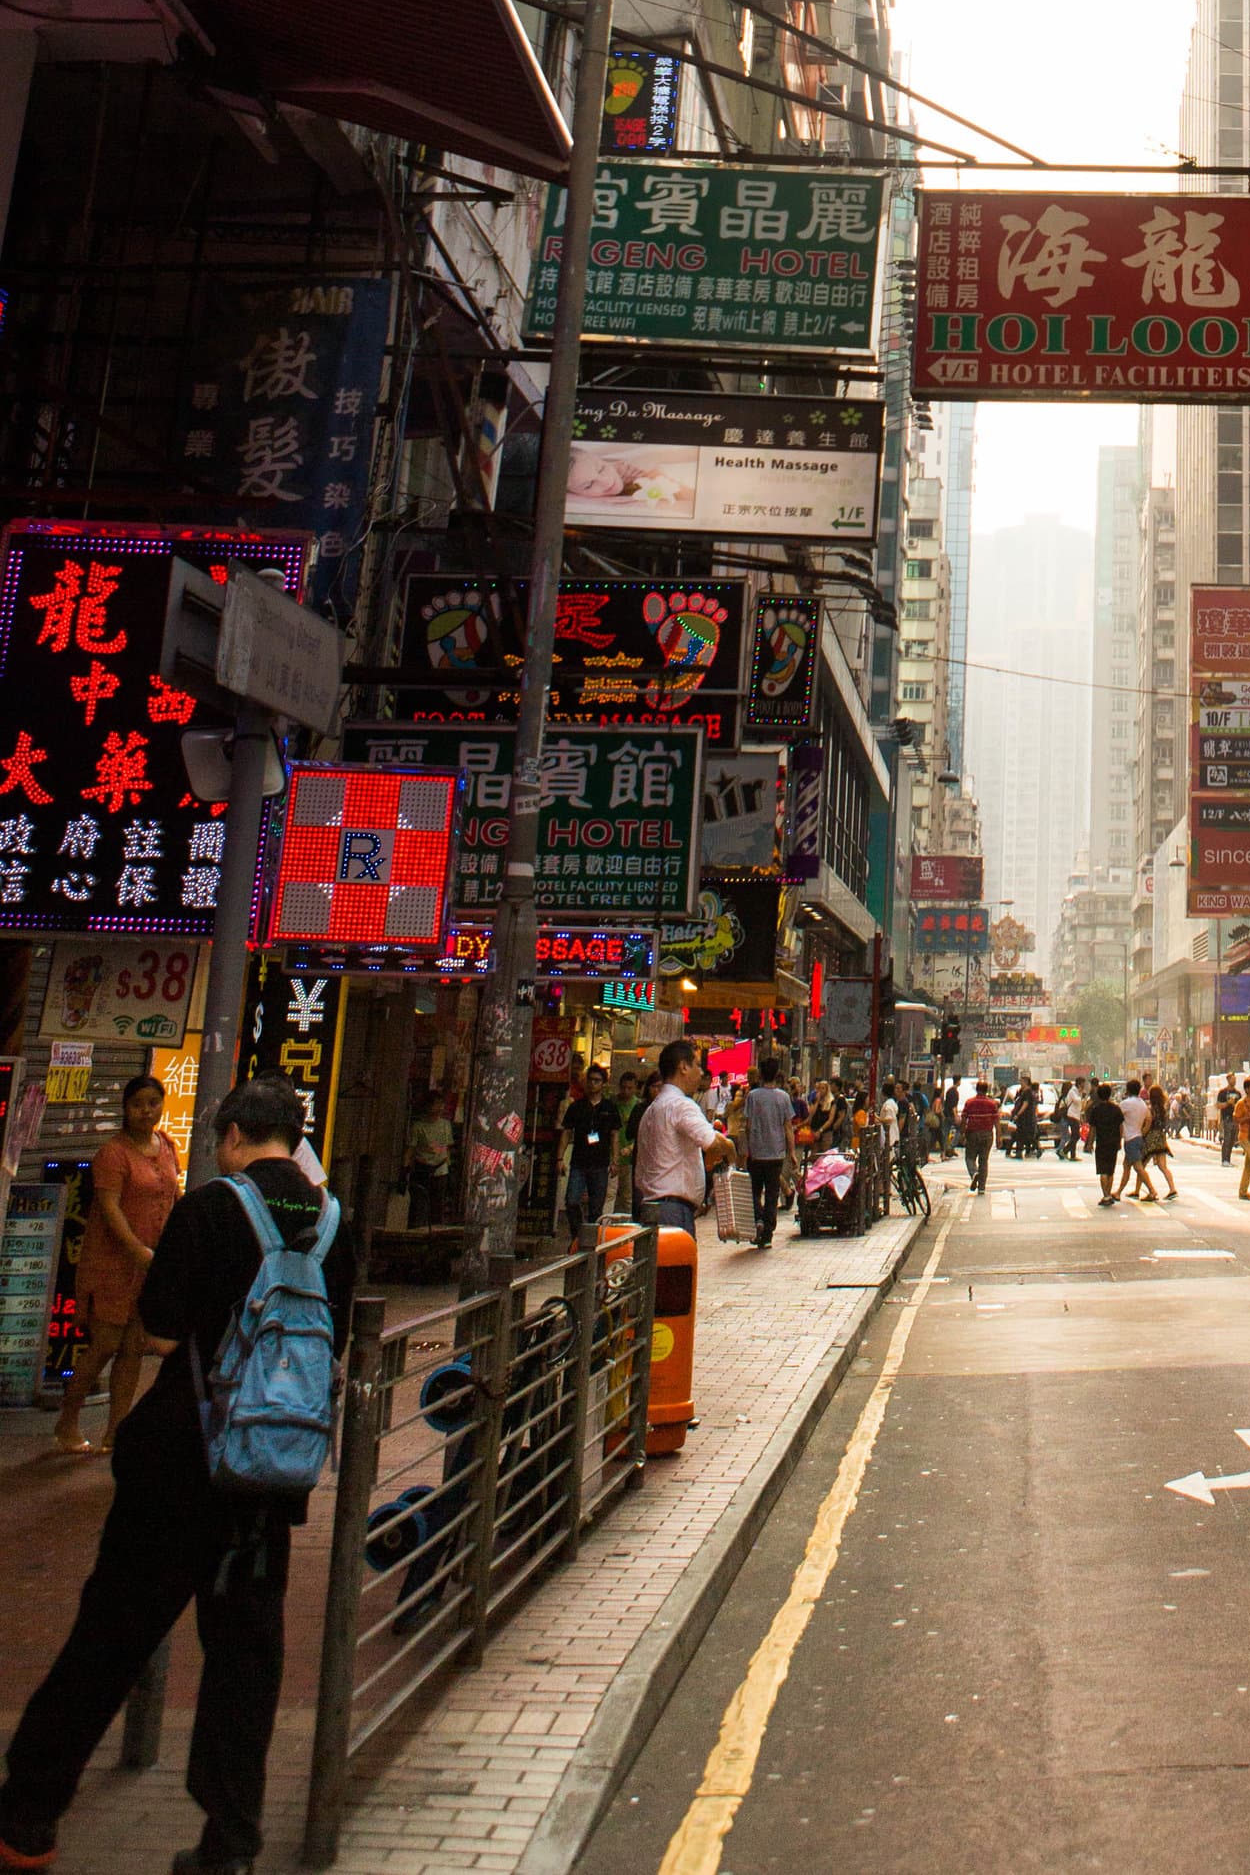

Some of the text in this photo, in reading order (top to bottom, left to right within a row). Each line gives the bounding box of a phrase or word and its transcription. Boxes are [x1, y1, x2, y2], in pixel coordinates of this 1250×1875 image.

[543, 235, 869, 280] RGENG HOTEL
[635, 302, 687, 318] LIENSED
[926, 312, 1071, 355] HOI
[989, 363, 1088, 386] HOTEL
[575, 400, 607, 423] ing
[642, 401, 726, 428] Massage
[714, 456, 839, 473] Health Massage
[837, 507, 865, 520] 1/F
[1205, 711, 1231, 727] 10/F
[1202, 808, 1225, 820] 12/F
[546, 817, 684, 849] HOTEL
[570, 880, 624, 893] FACILITY
[590, 894, 632, 906] FREE
[637, 894, 677, 906] WFI
[1197, 894, 1227, 910] KING
[536, 938, 624, 964] SSAGE
[115, 949, 190, 1002] $38
